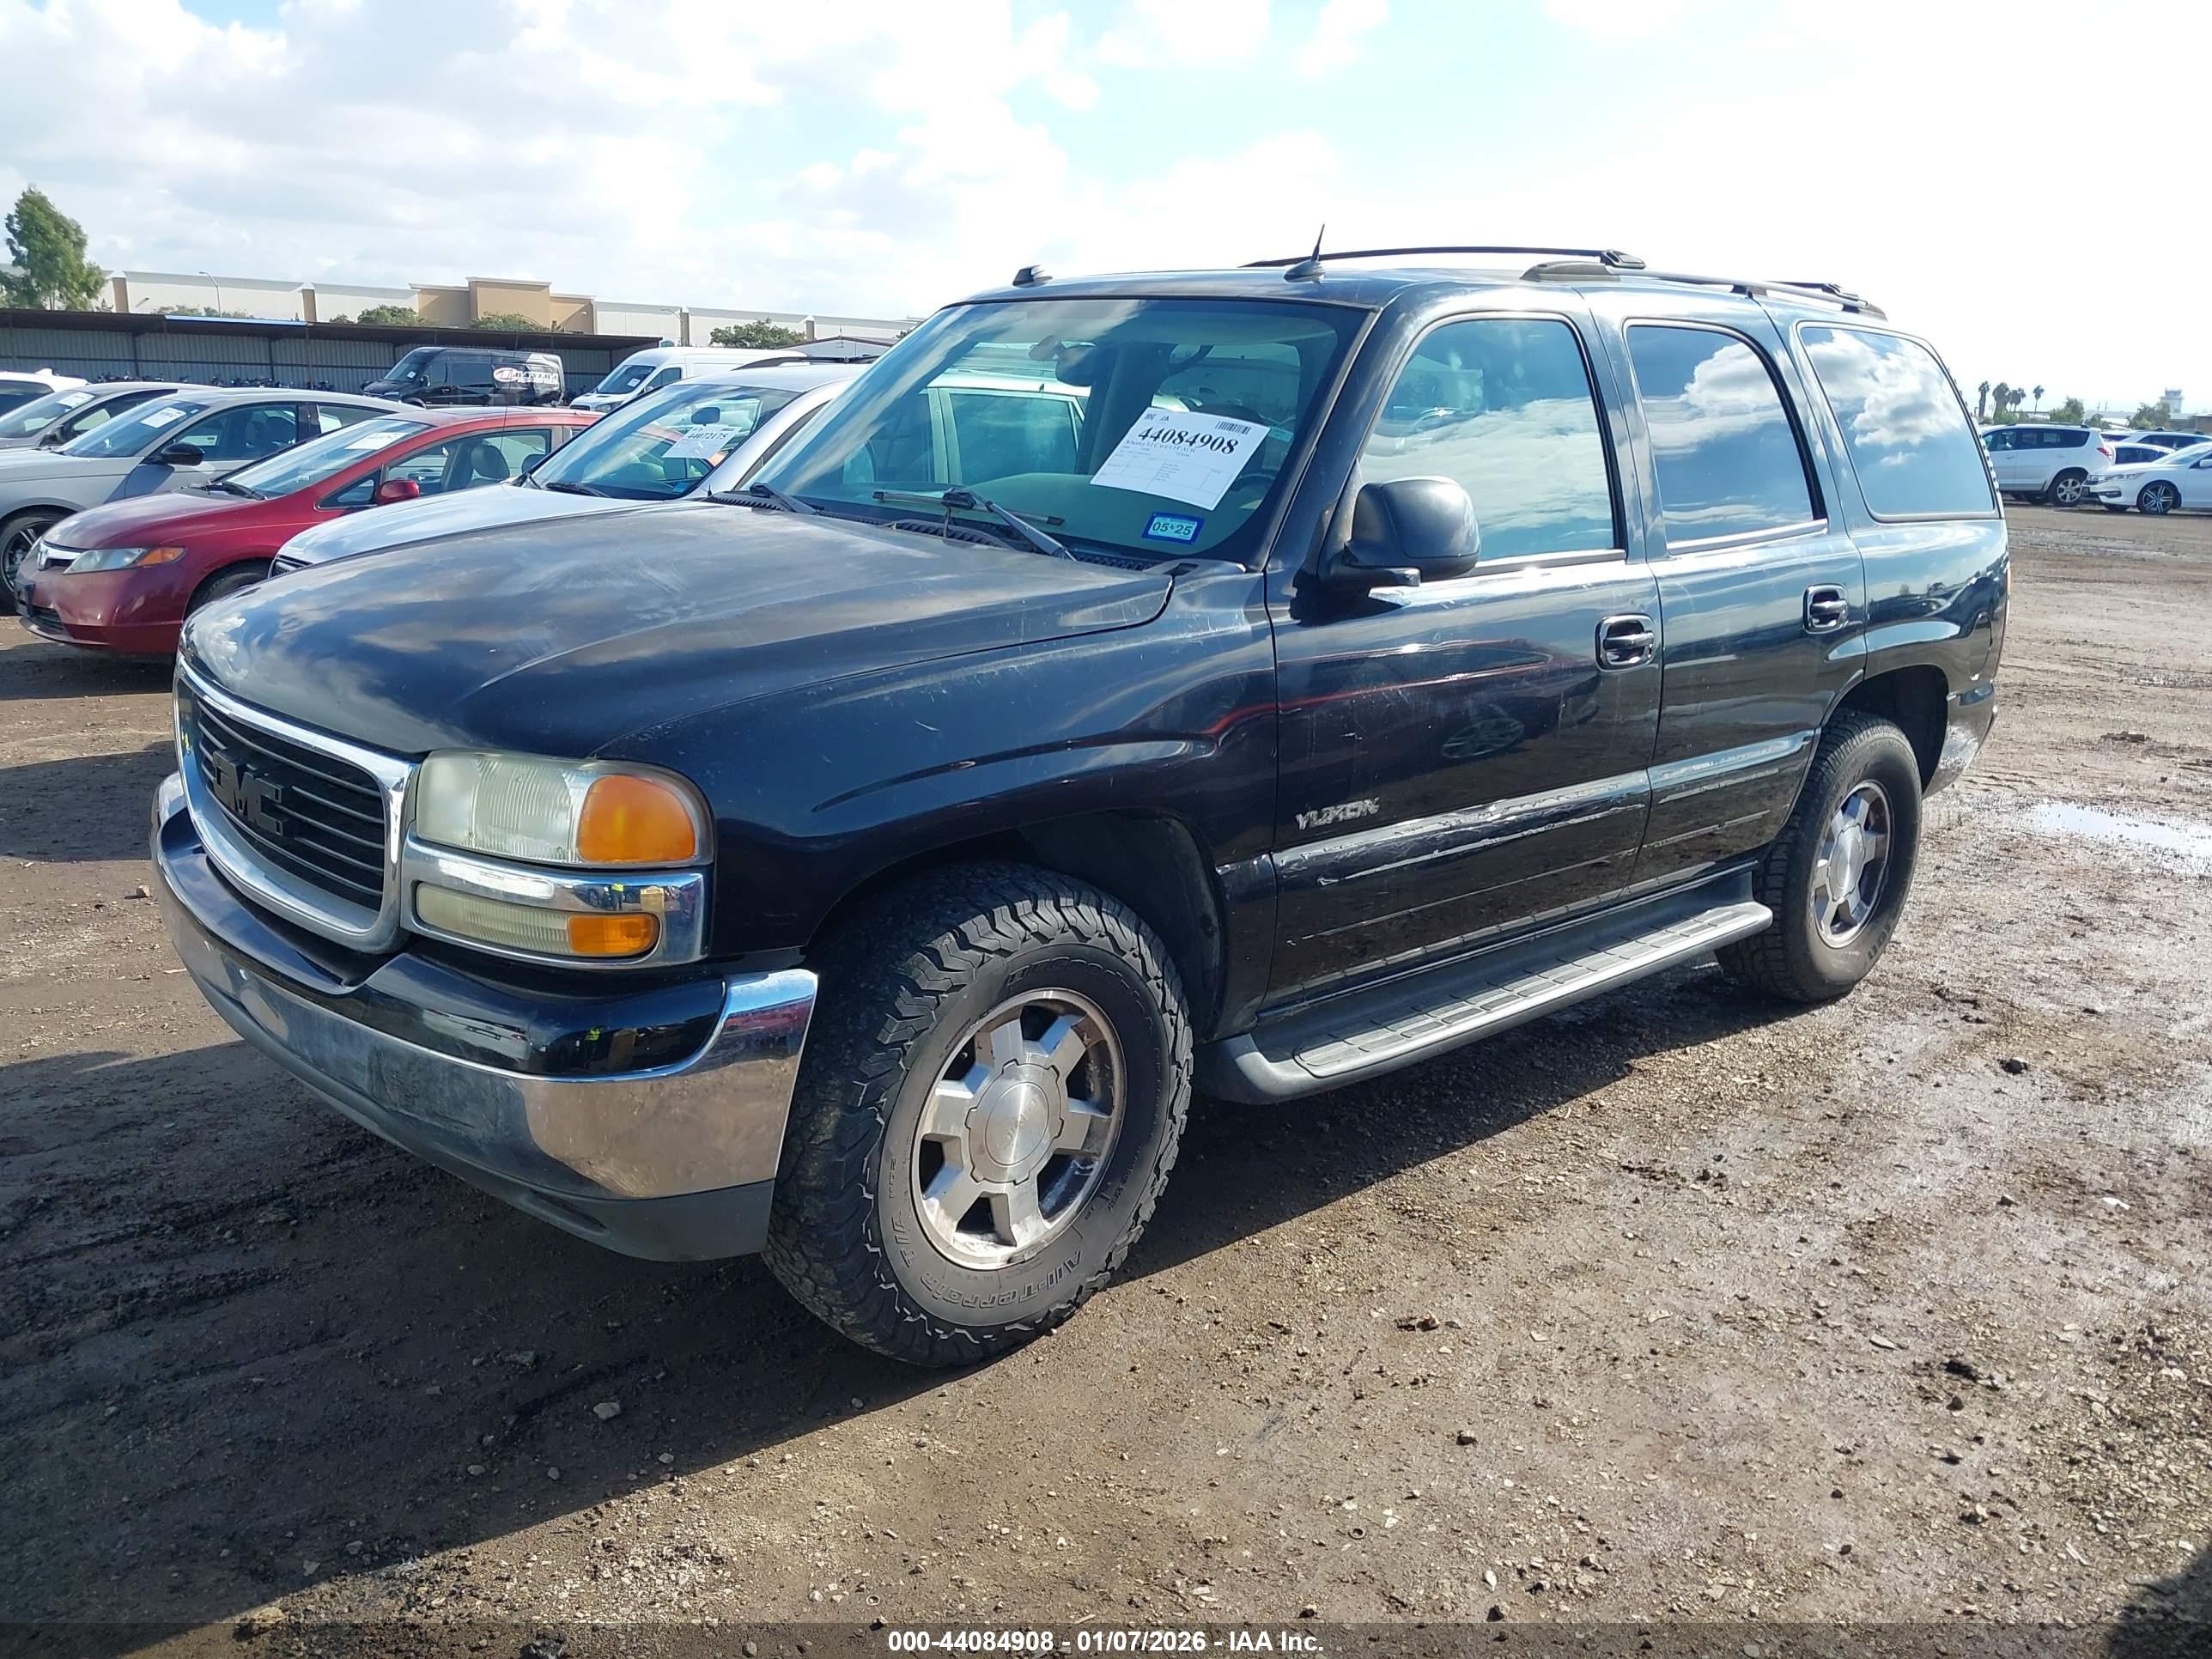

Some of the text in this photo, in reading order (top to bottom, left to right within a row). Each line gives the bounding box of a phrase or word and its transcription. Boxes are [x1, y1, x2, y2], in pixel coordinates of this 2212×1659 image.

[1138, 426, 1239, 455] 44084908
[1152, 521, 1170, 532] 05
[1174, 524, 1193, 536] 25
[1295, 797, 1381, 830] YUKON
[920, 1249, 1082, 1310] All-Terrain
